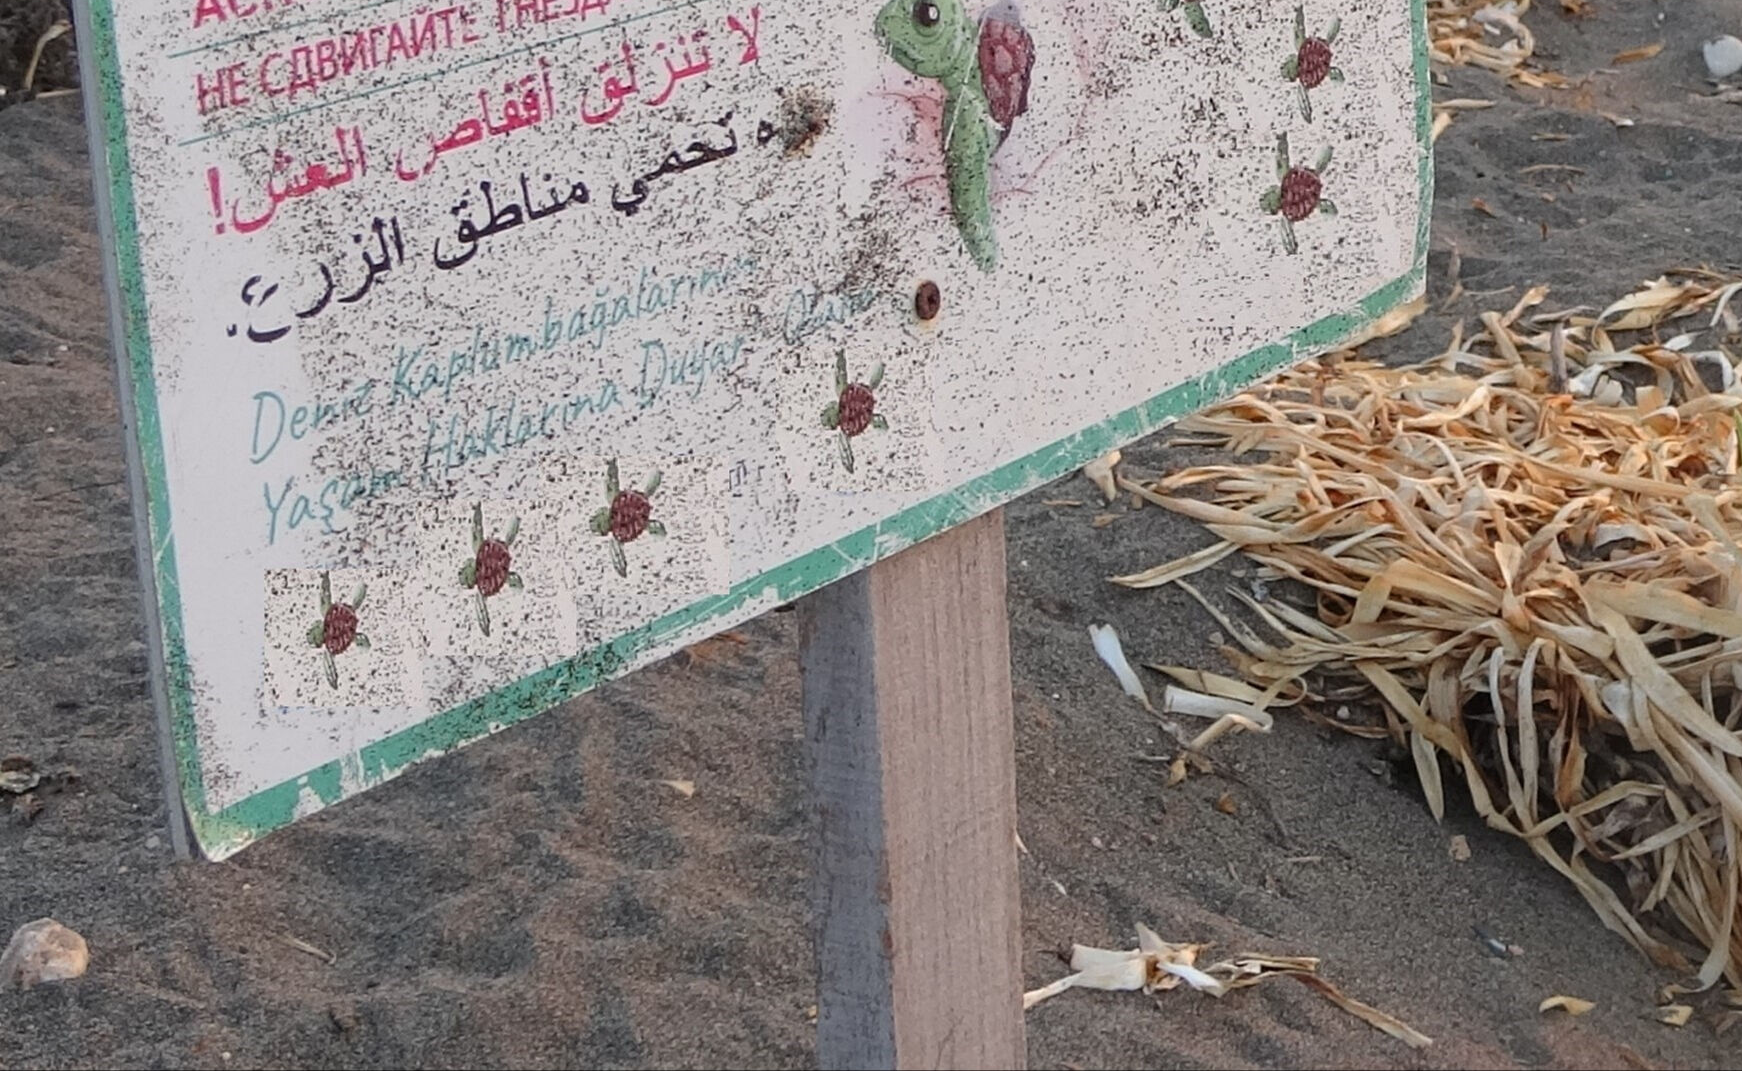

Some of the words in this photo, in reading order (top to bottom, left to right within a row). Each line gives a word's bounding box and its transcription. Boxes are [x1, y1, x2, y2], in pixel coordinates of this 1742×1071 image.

[726, 6, 762, 65] لا
[196, 61, 250, 116] НЕ
[433, 172, 590, 270] مناطق
[250, 383, 373, 465] Deniz
